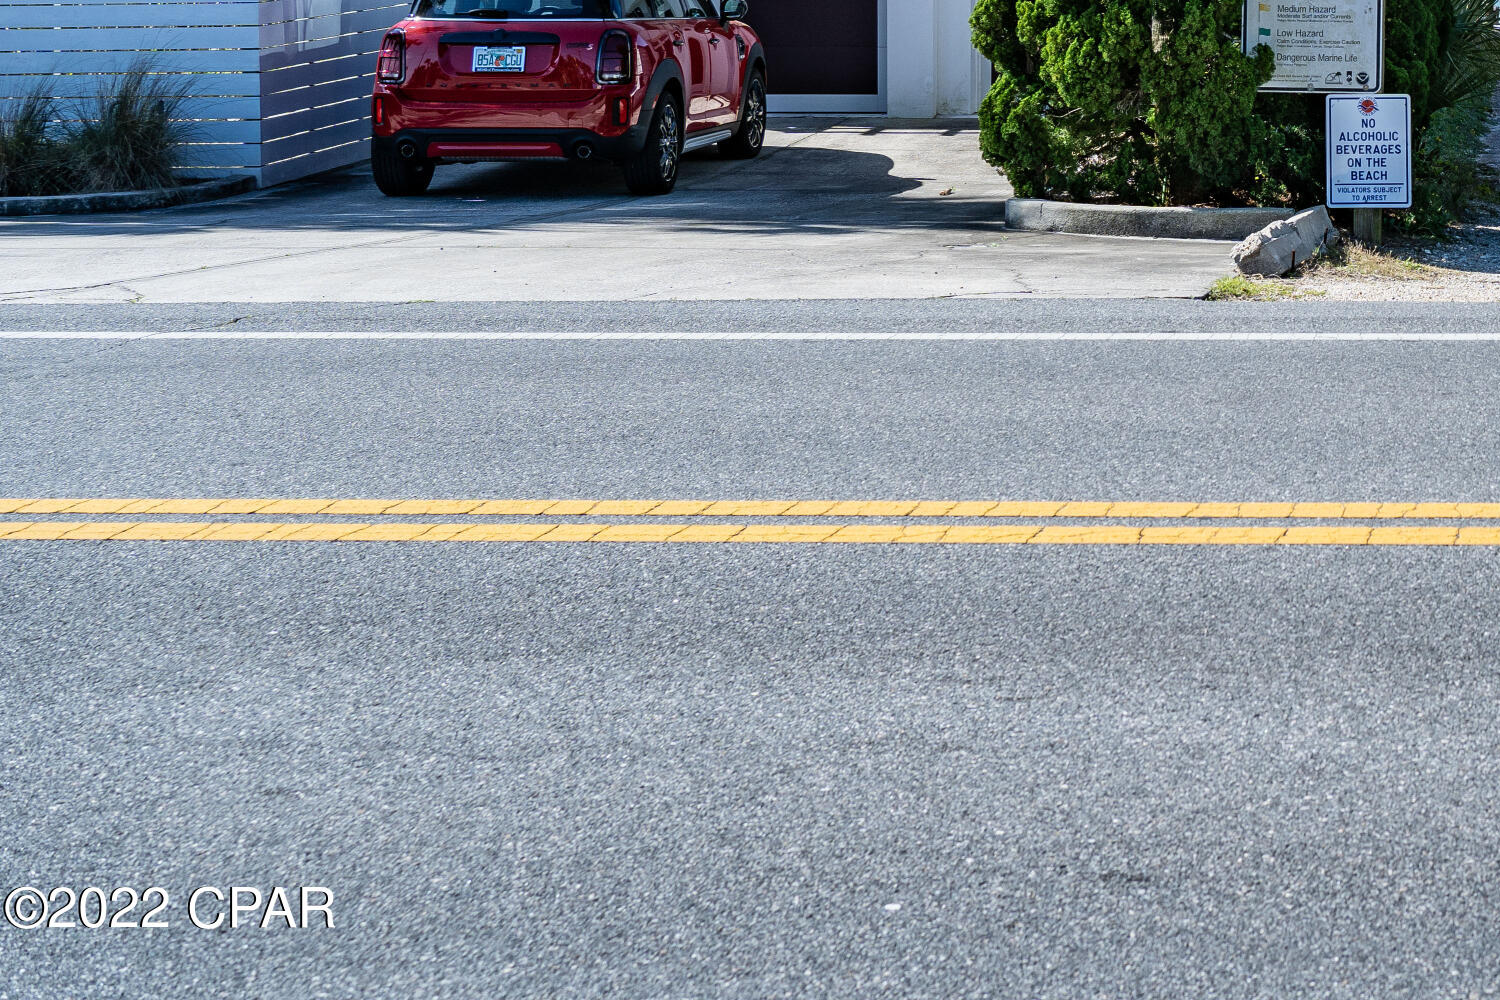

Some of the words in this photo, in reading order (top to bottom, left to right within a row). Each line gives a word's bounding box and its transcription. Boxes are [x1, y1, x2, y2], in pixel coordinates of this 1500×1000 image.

[1277, 5, 1307, 13] Medium
[1309, 5, 1336, 13] Hazard
[1295, 29, 1323, 37] Hazard
[1277, 53, 1316, 63] Dangerous
[1318, 54, 1343, 62] Marine
[1344, 54, 1358, 62] Life
[1362, 119, 1375, 128] NO
[1339, 132, 1398, 141] ALCOHOLIC
[1336, 145, 1401, 154] BEVERAGES
[1348, 158, 1362, 167] ON
[1366, 158, 1386, 167] THE
[1351, 171, 1387, 180] BEACH
